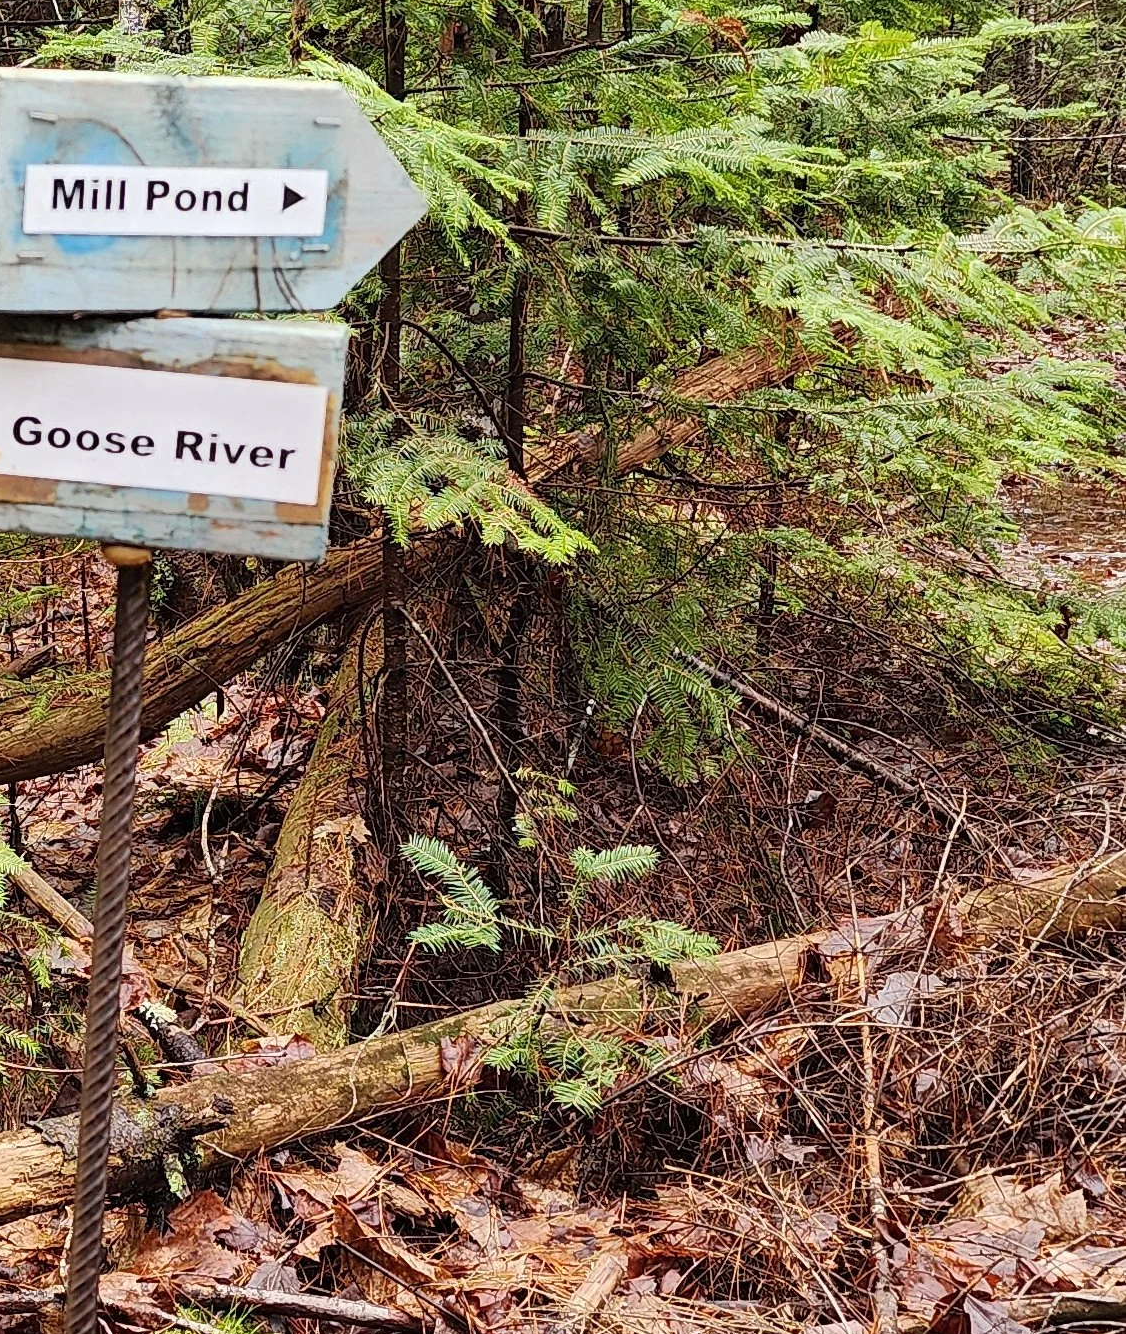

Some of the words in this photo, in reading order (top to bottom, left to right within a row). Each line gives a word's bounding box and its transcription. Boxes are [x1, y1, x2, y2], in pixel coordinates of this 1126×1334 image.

[52, 178, 127, 211] Mill
[146, 180, 249, 213] Pond
[12, 416, 155, 457] Goose
[175, 430, 296, 470] River
